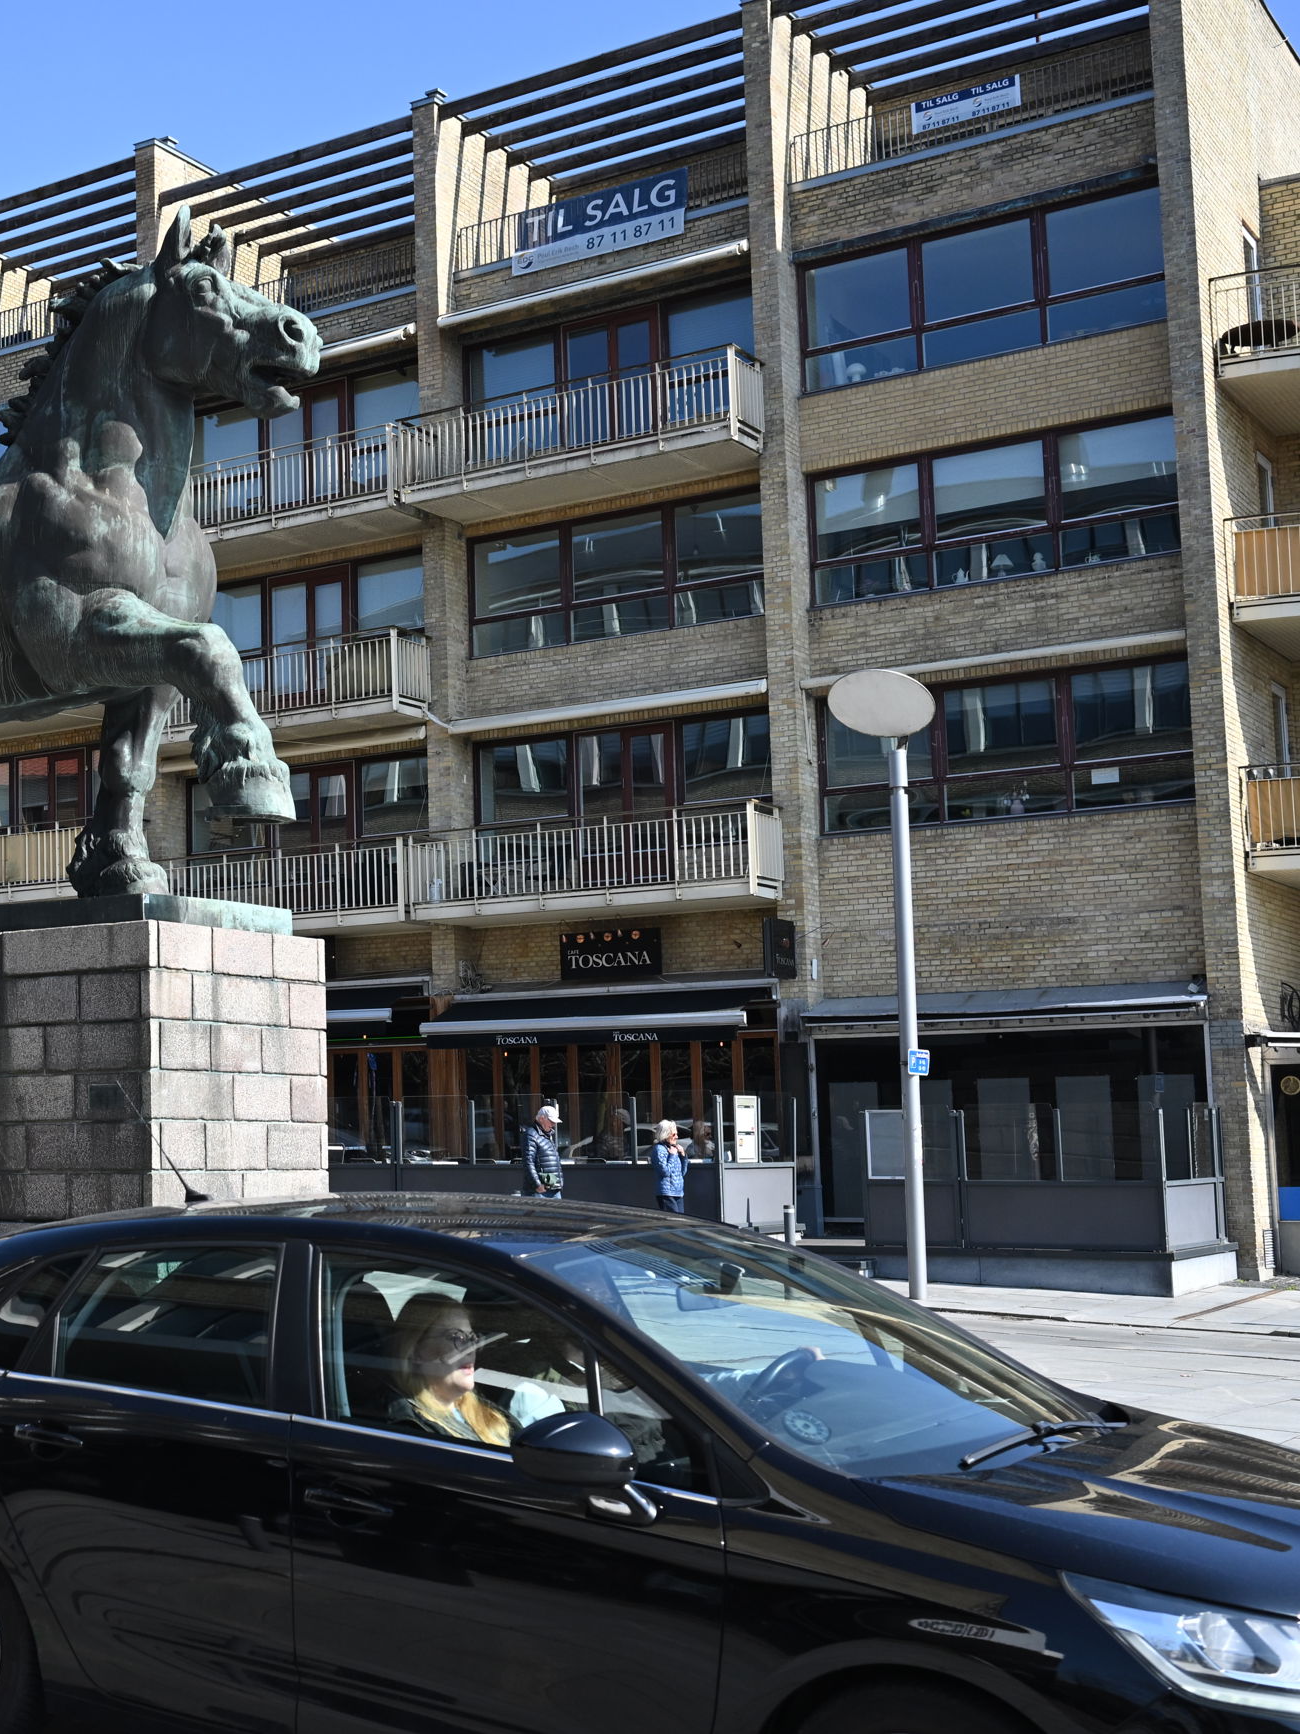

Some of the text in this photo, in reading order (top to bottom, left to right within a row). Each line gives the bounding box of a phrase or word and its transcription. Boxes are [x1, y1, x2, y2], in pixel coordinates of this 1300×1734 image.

[971, 79, 1009, 95] TIL SALG
[921, 93, 959, 108] TIL SALG
[525, 179, 676, 242] TIL SALG
[586, 216, 675, 250] 87 11 87 11
[568, 951, 652, 969] TOSCANA
[496, 1036, 538, 1045] TOSCANA
[612, 1033, 658, 1042] TOSCANA
